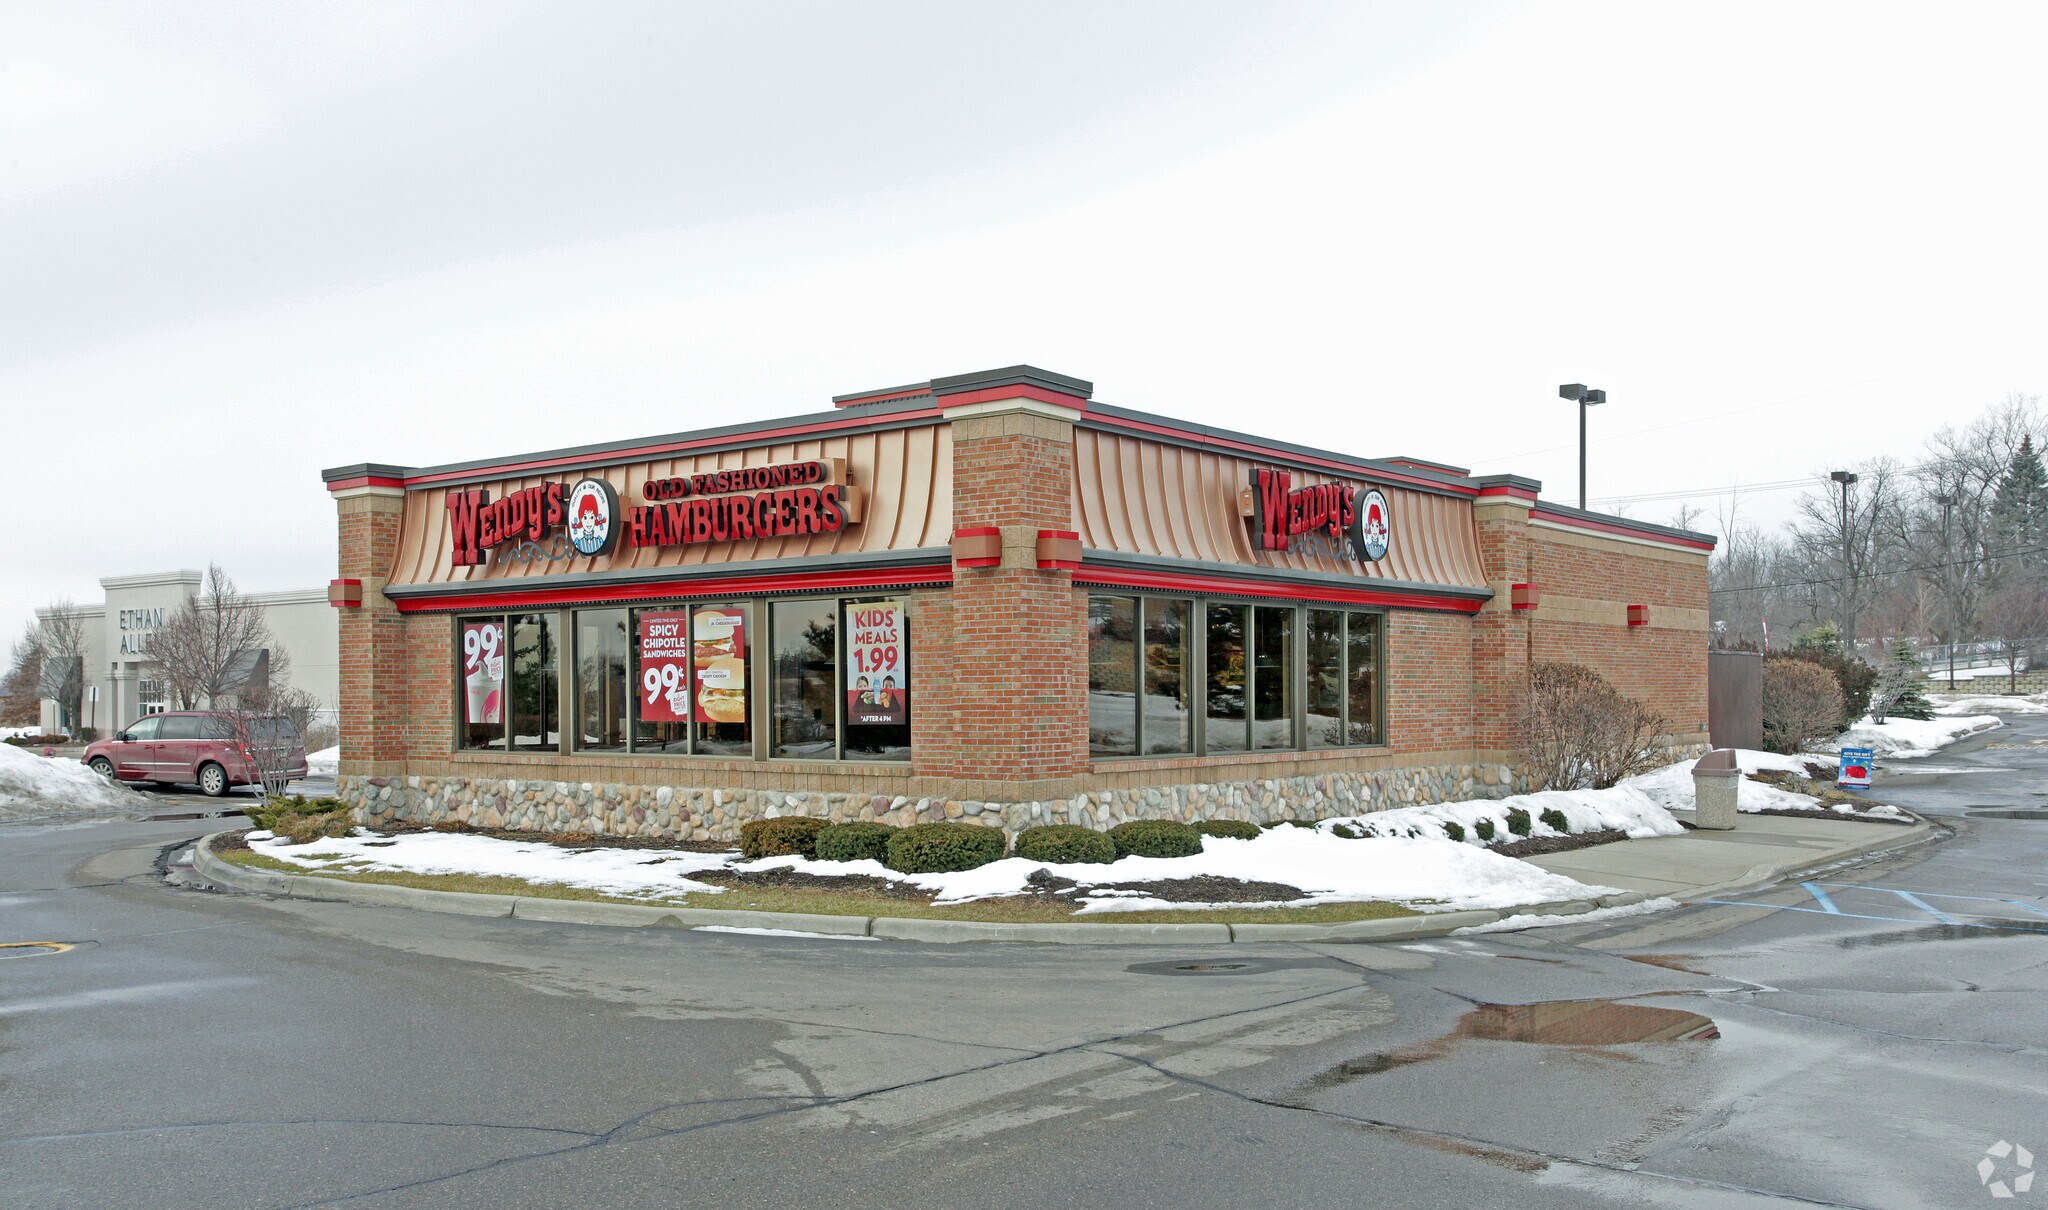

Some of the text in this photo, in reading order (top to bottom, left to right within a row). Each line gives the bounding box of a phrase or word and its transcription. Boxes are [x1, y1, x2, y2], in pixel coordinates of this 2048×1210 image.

[643, 461, 826, 500] OLD FASHIONED
[629, 485, 847, 548] HAMBURGERS
[120, 608, 163, 629] ETHAN
[649, 624, 678, 637] SPICY
[855, 629, 898, 644] MEALS
[120, 633, 163, 653] ALLE
[643, 638, 685, 649] CHIPOTLE
[643, 650, 686, 658] SANDWICHES
